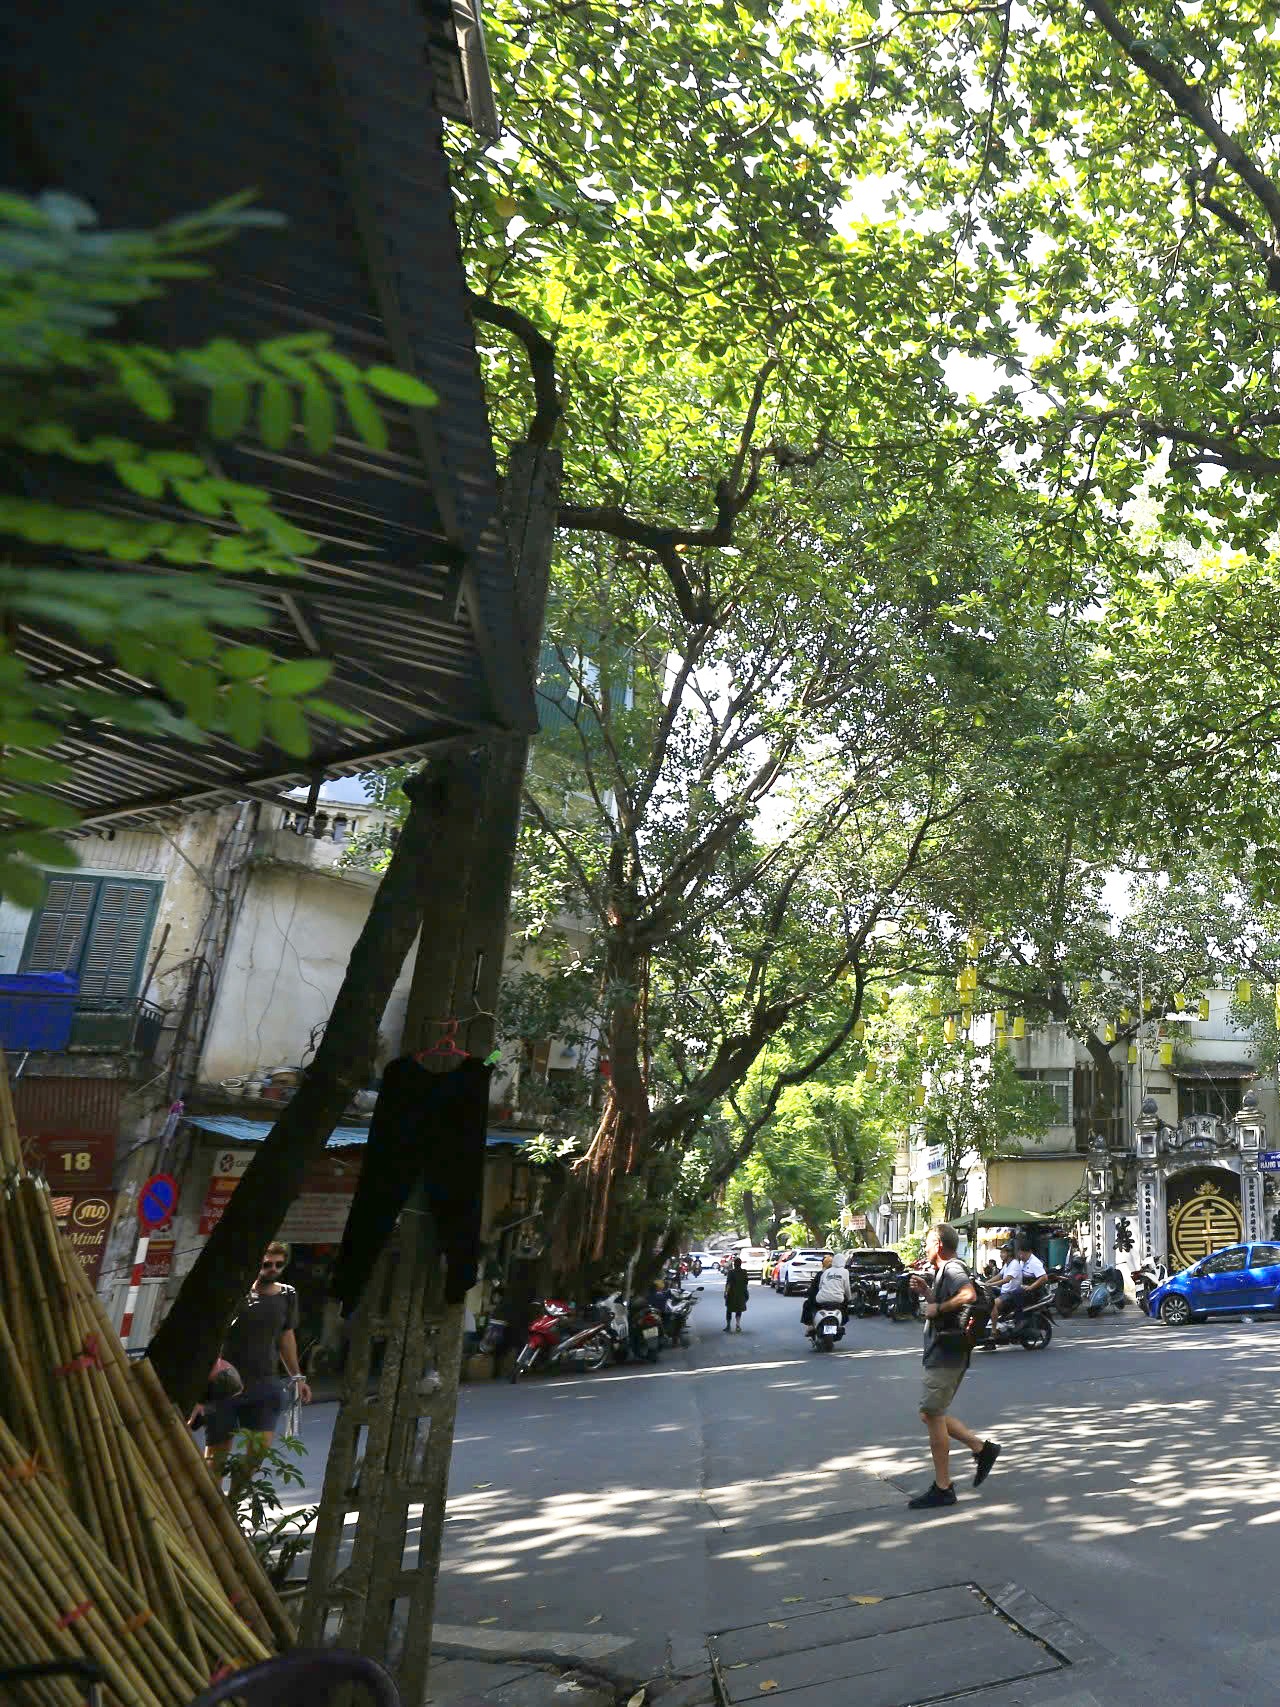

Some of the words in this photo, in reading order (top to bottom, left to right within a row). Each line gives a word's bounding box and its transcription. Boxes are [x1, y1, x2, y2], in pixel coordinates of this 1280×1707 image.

[61, 1152, 91, 1171] 18
[1260, 1160, 1276, 1169] HÀNG
[69, 1229, 105, 1246] Minh
